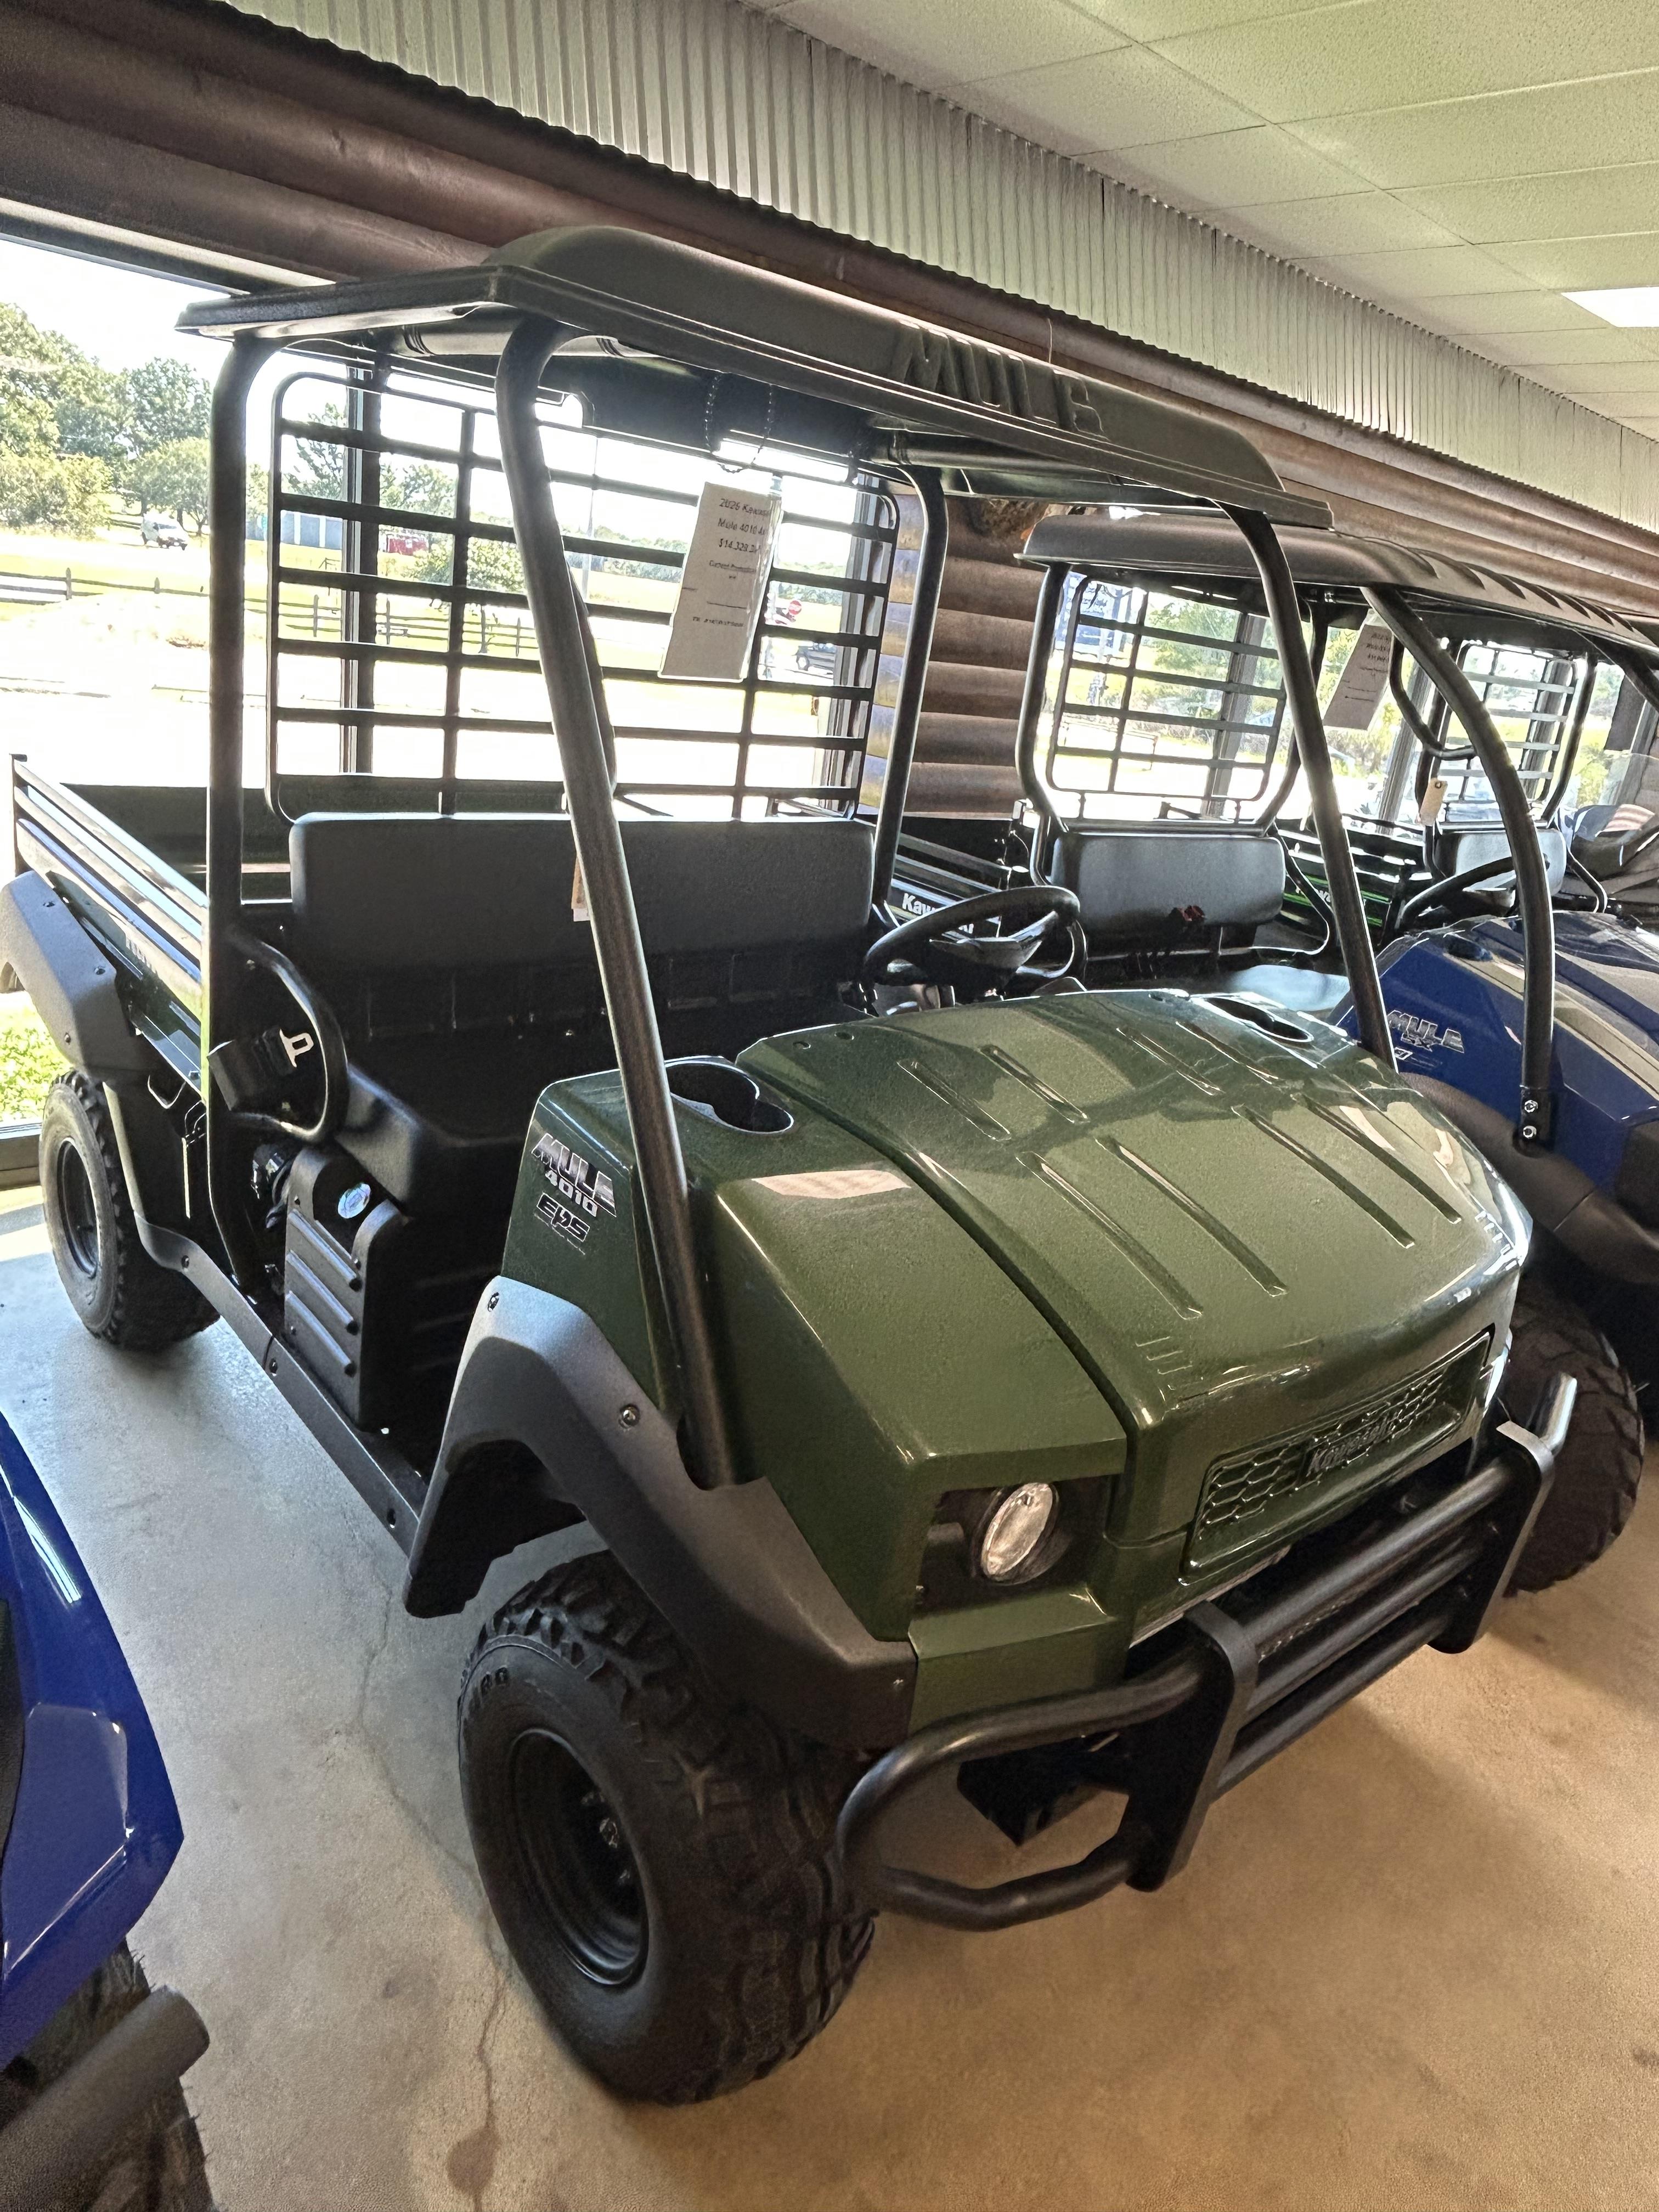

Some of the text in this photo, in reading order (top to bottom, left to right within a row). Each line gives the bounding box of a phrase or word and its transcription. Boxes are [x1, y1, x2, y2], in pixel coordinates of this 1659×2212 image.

[890, 319, 1109, 441] MULE
[1387, 1009, 1465, 1053] MULE
[531, 1132, 617, 1218] MULE
[545, 1170, 599, 1217] 4010
[537, 1192, 591, 1242] EPS
